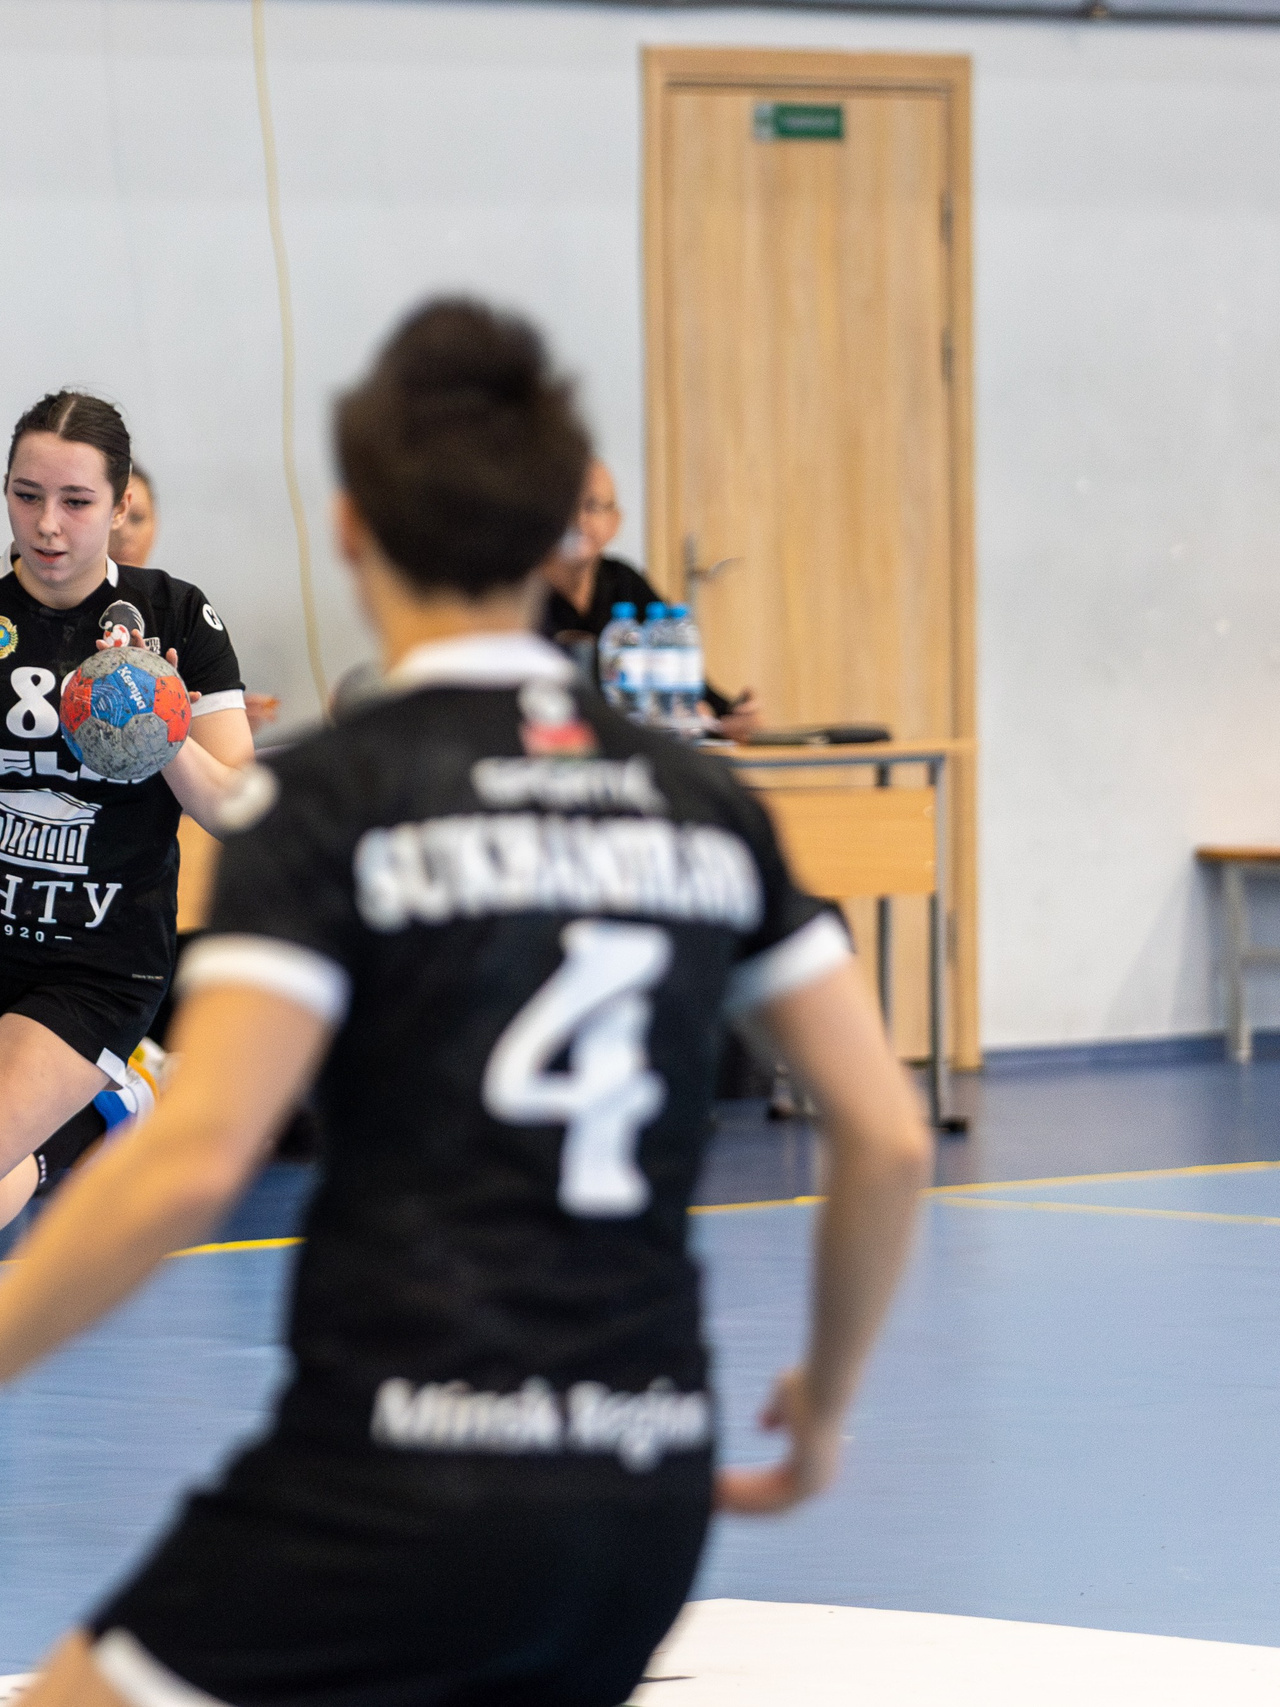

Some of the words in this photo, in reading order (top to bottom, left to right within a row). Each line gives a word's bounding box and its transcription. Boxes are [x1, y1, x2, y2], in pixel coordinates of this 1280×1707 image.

[6, 666, 78, 738] 8
[117, 666, 147, 710] Kempa
[482, 918, 672, 1218] 4
